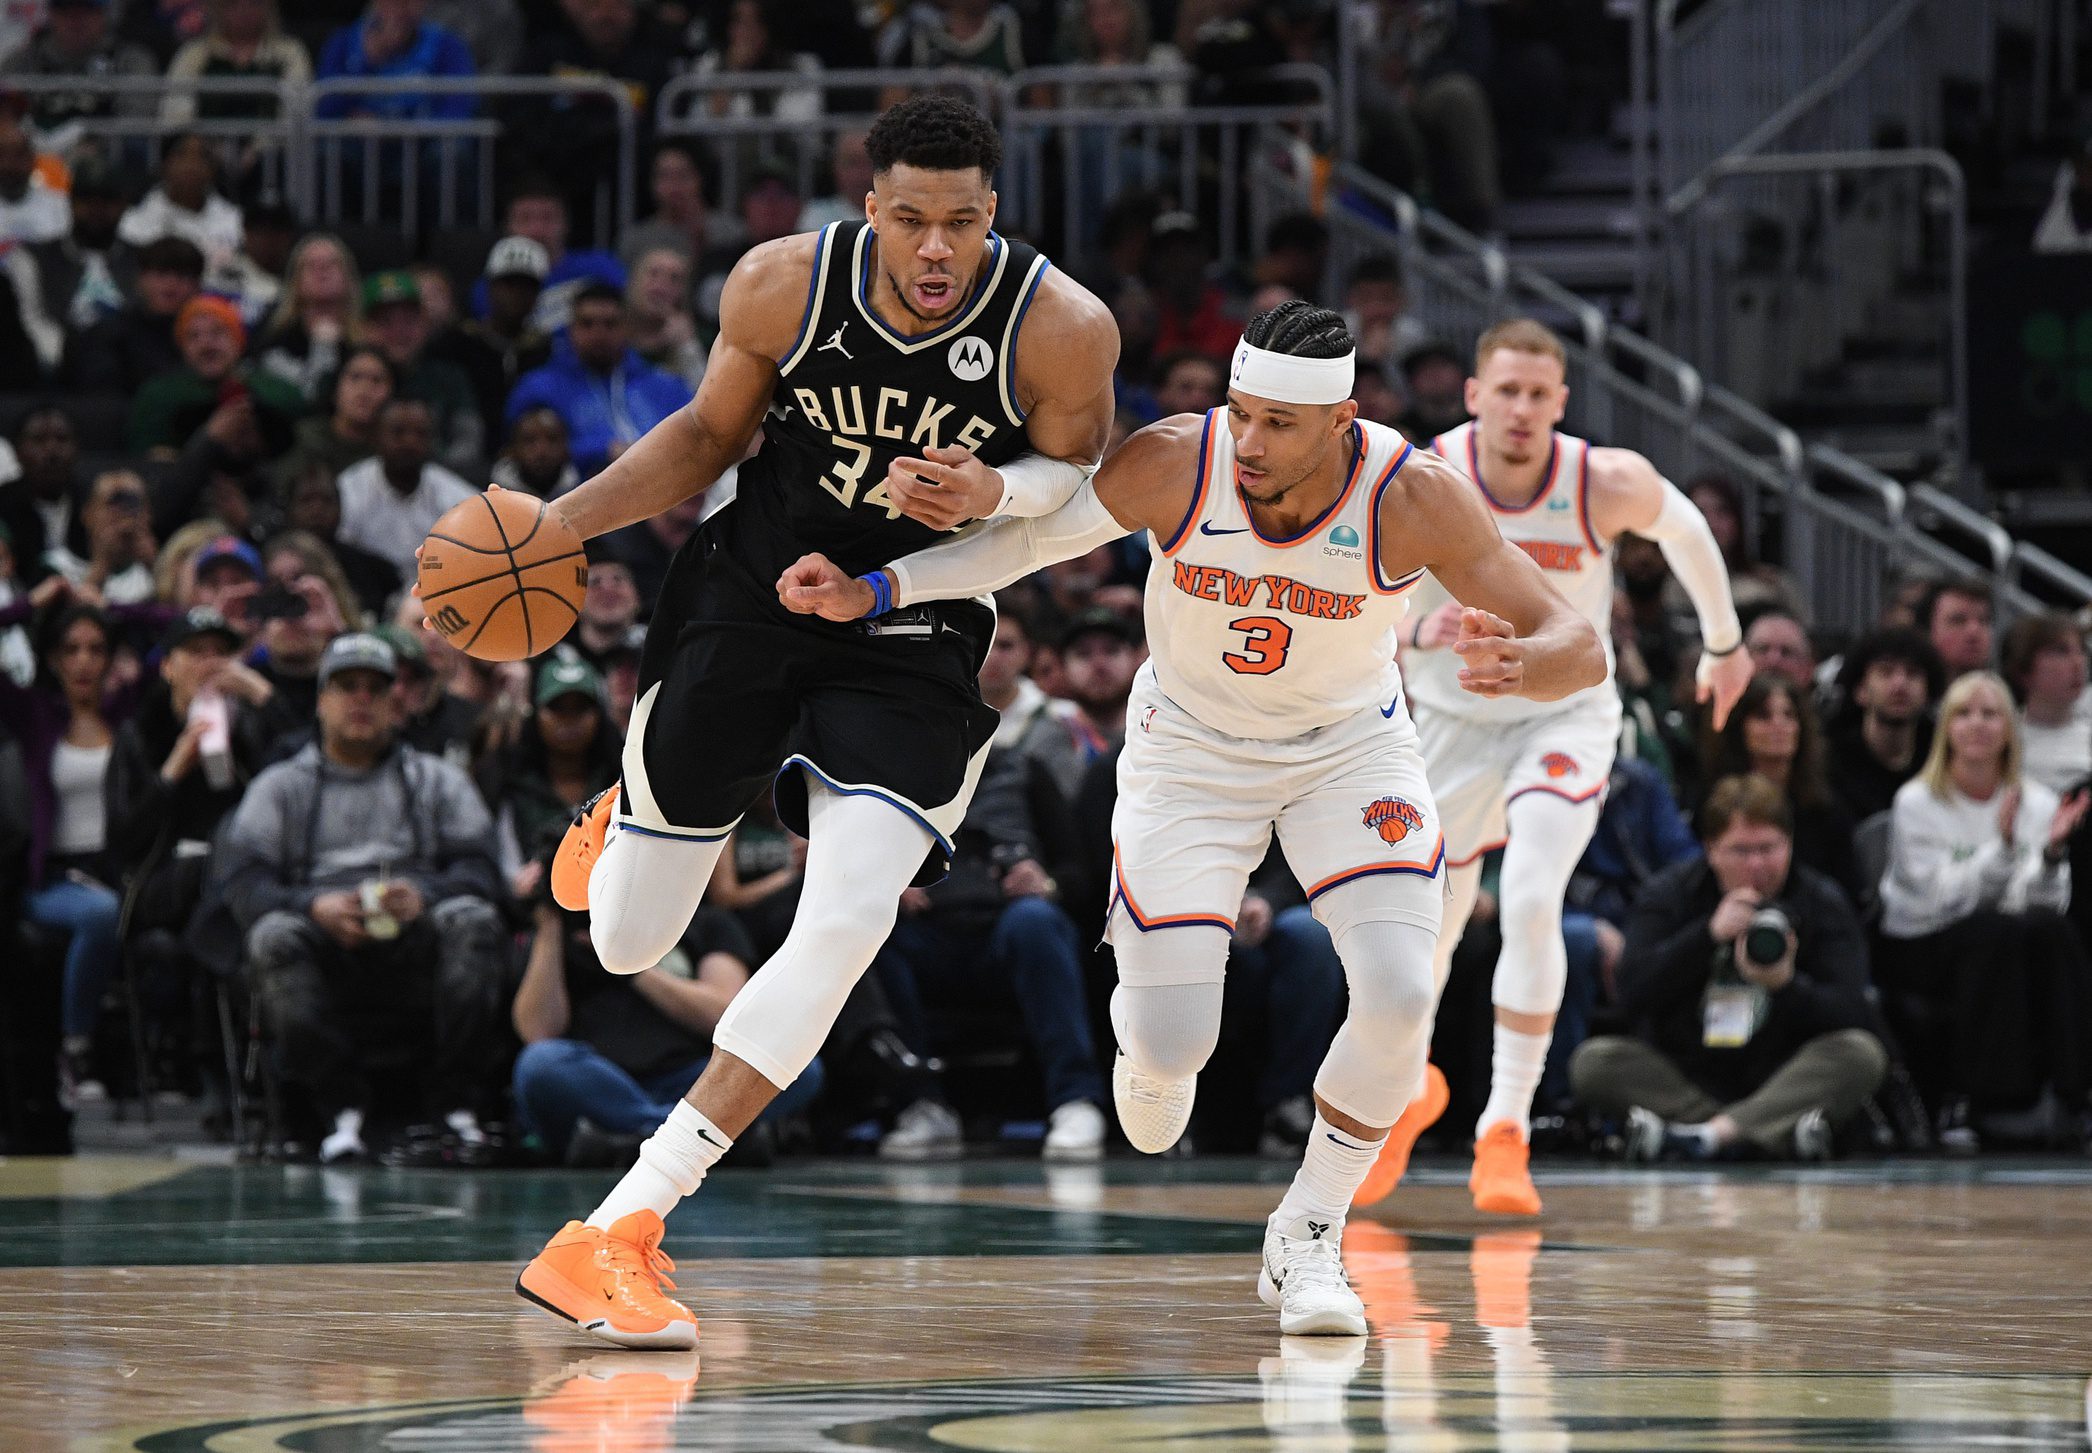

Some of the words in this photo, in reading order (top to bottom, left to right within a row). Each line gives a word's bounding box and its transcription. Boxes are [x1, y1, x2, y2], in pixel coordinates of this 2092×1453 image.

[794, 386, 997, 453] BUCKS
[1323, 547, 1362, 560] sphere
[1516, 540, 1583, 572] ORK
[1173, 560, 1261, 608] NEW
[1262, 575, 1368, 620] YORK
[1222, 616, 1293, 675] 3
[1363, 800, 1423, 830] KNICKS
